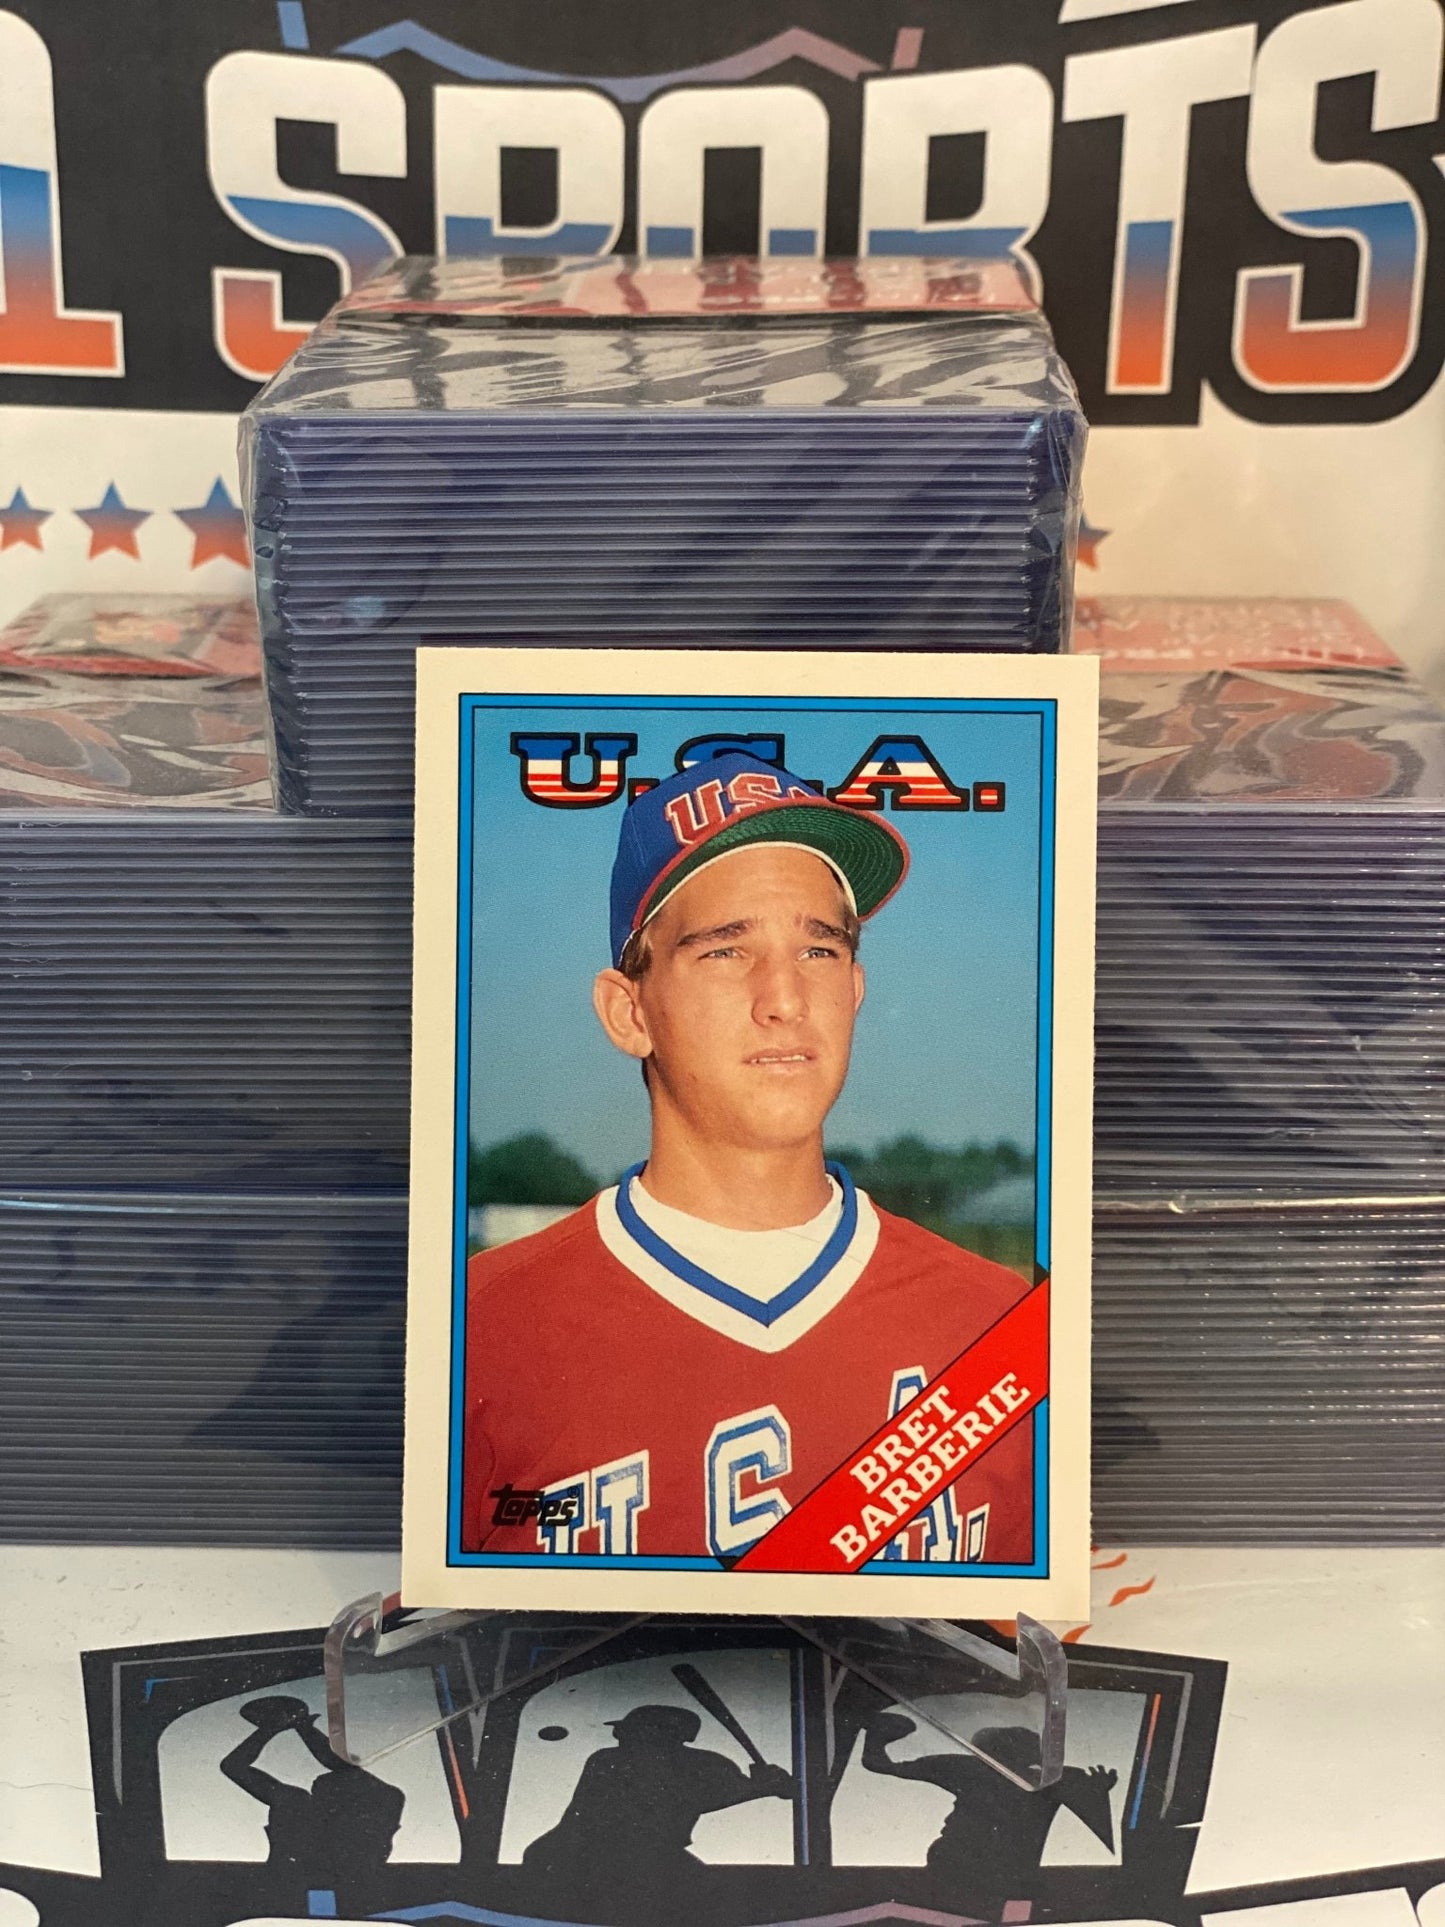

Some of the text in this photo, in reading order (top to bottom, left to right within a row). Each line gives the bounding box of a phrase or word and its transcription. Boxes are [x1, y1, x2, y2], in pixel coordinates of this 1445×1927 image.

[204, 0, 1444, 394] SPORTS
[510, 732, 1005, 812] U.A.
[665, 772, 817, 846] US
[829, 1371, 1032, 1564] BARBERIE
[849, 1385, 957, 1495] BRET
